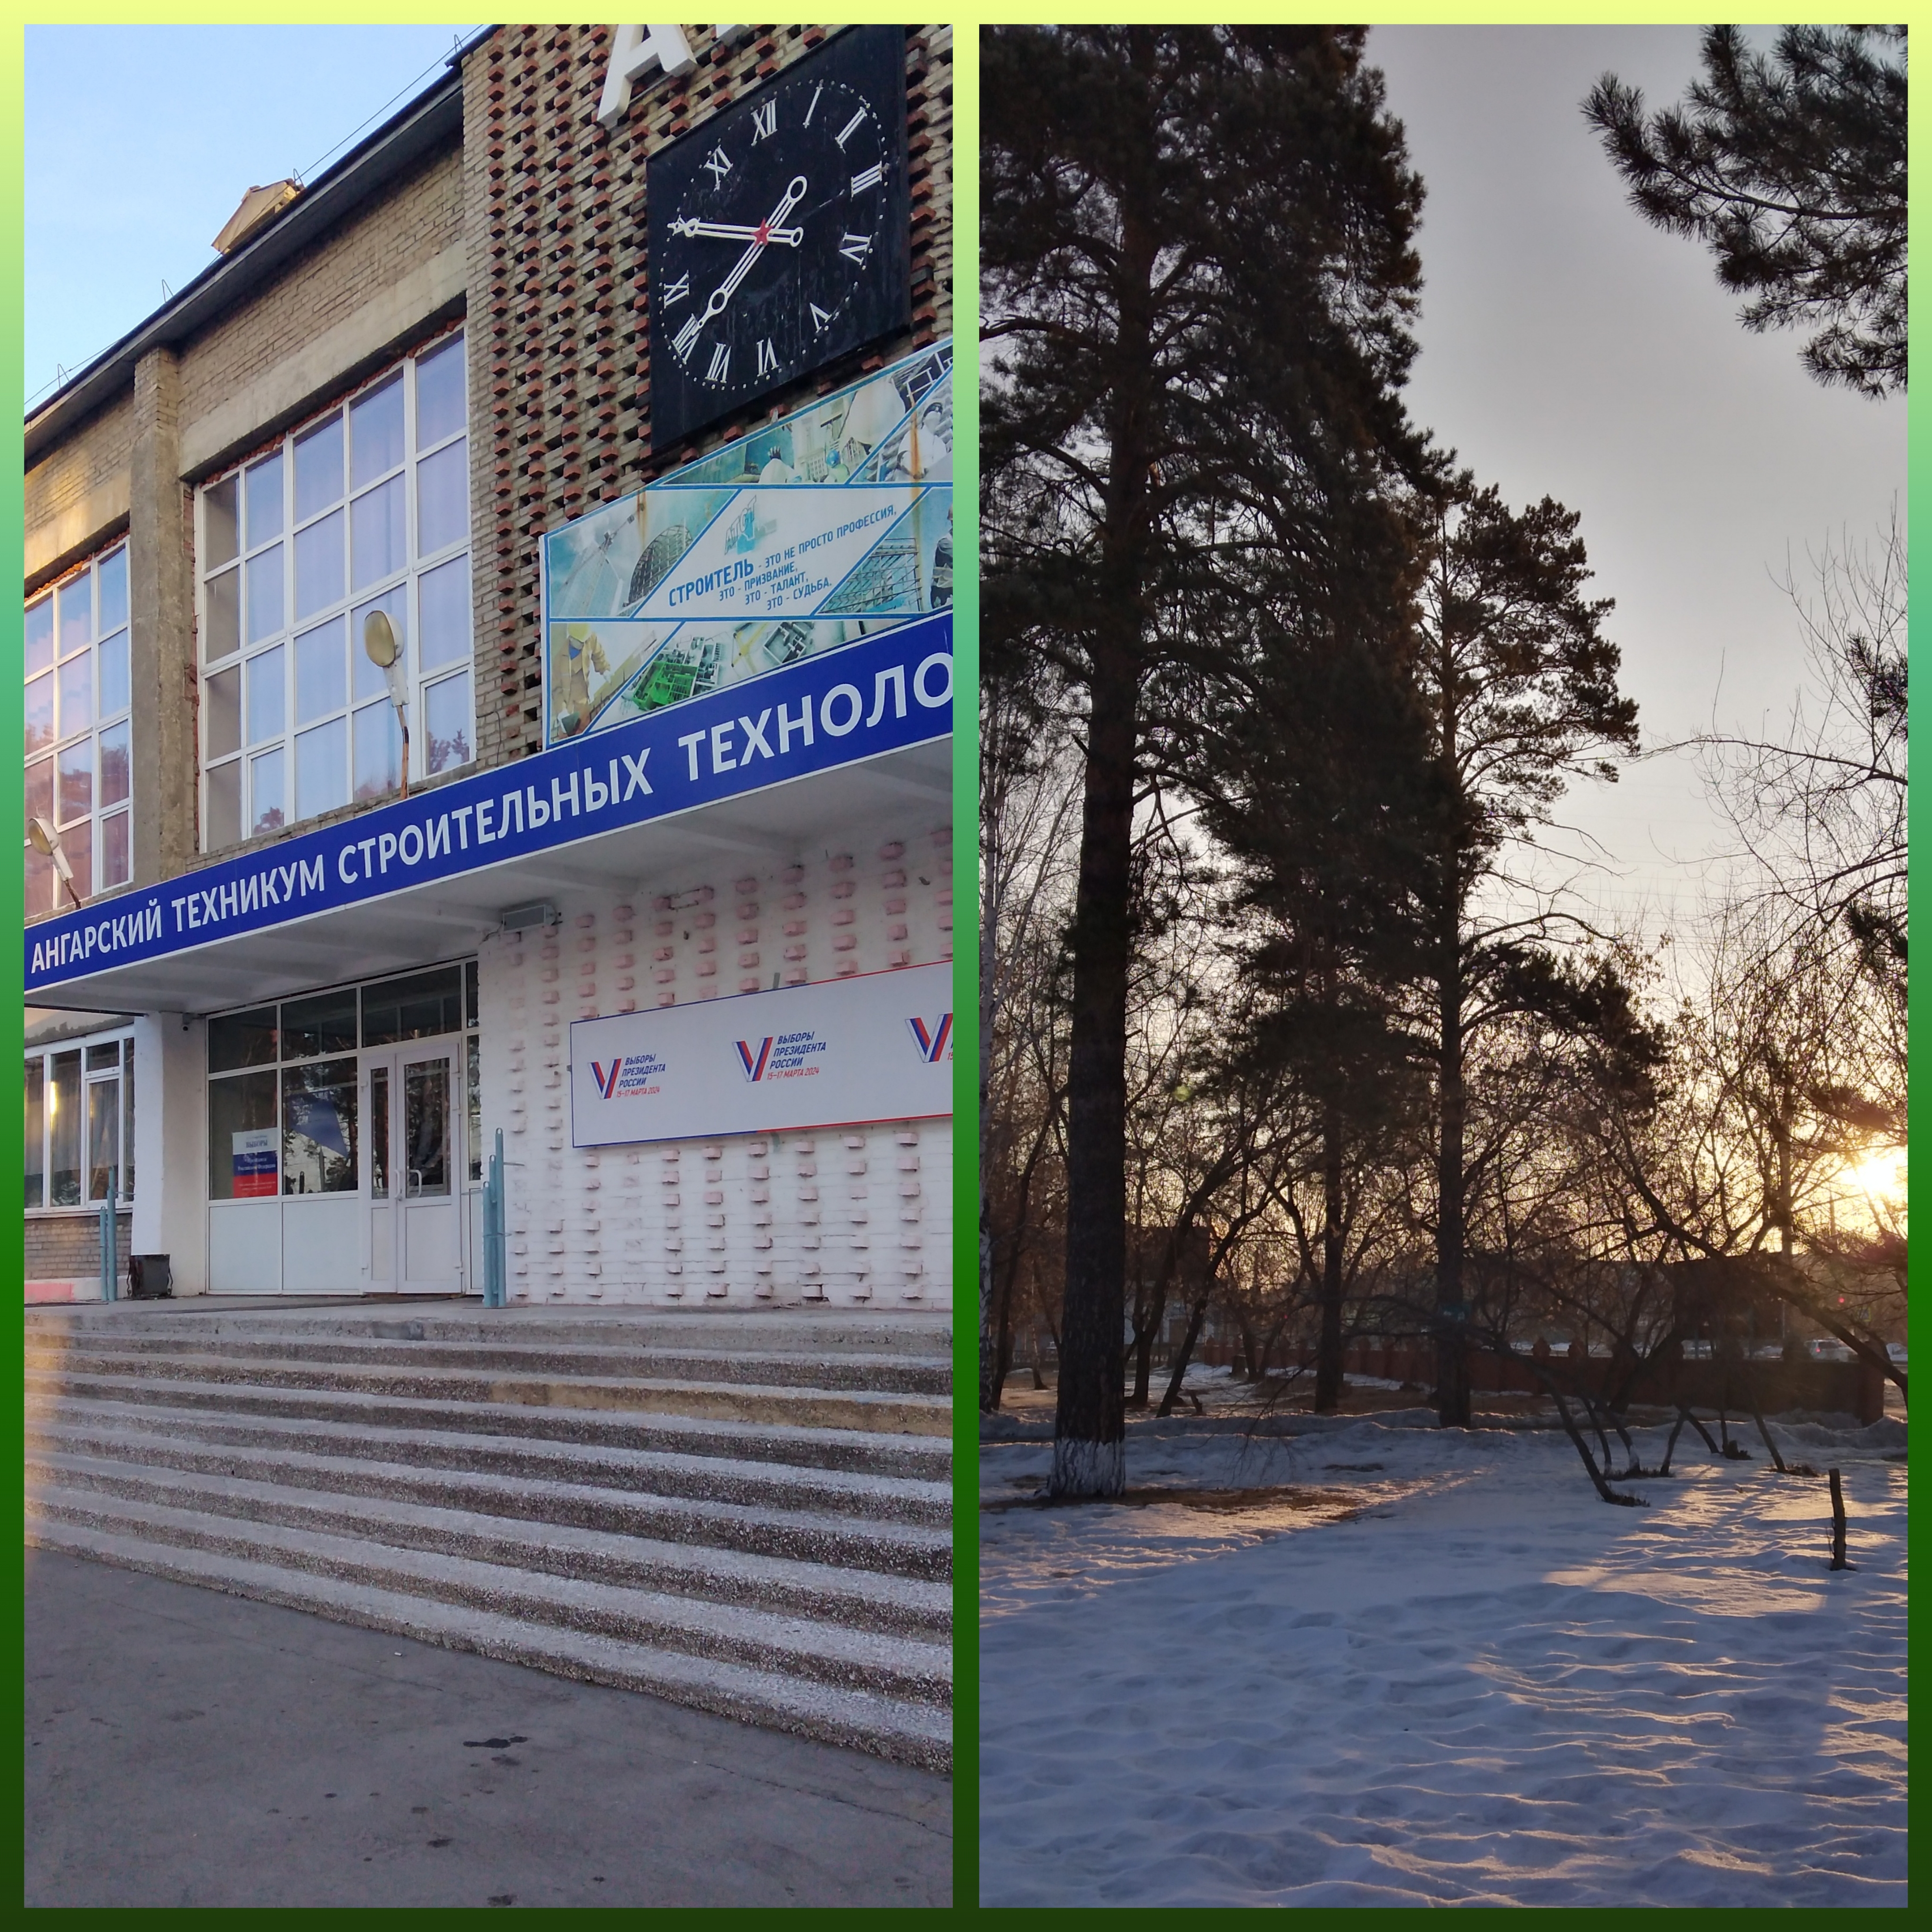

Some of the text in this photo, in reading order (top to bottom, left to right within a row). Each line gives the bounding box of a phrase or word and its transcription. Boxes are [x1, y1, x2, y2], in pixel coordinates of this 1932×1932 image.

[669, 558, 754, 607] СТРОИТЕЛЬ
[765, 553, 781, 568] ЭТО
[784, 546, 796, 560] НЕ
[799, 531, 833, 555] ПРОСТО
[836, 504, 897, 539] ПРОФЕССИЯ,
[719, 586, 734, 601] ЭТО
[744, 561, 798, 591] ПРИЗВАНИЕ,
[745, 590, 761, 605] ЭТО
[770, 571, 808, 594] ТАЛАНТ,
[767, 595, 783, 610] ЭТО
[793, 577, 832, 600] СУДЬБА.
[31, 652, 953, 974] АНГАРСКИЙ ТЕХНИКУМ СТРОИТЕЛЬНЫХ ТЕХНОЛО
[777, 1031, 815, 1045] ВЫБОРЫ
[774, 1042, 826, 1057] ПРЕЗИДЕНТА
[625, 1054, 656, 1066] ВЫБОРЫ
[770, 1057, 804, 1069] РОССИИ
[622, 1064, 666, 1077] ПРЕЗИДЕНТА
[783, 1069, 803, 1078] МАРТА
[804, 1067, 820, 1076] 2024
[619, 1077, 647, 1088] РОССИИ
[630, 1087, 647, 1096] МАРТА
[648, 1086, 660, 1094] 2024
